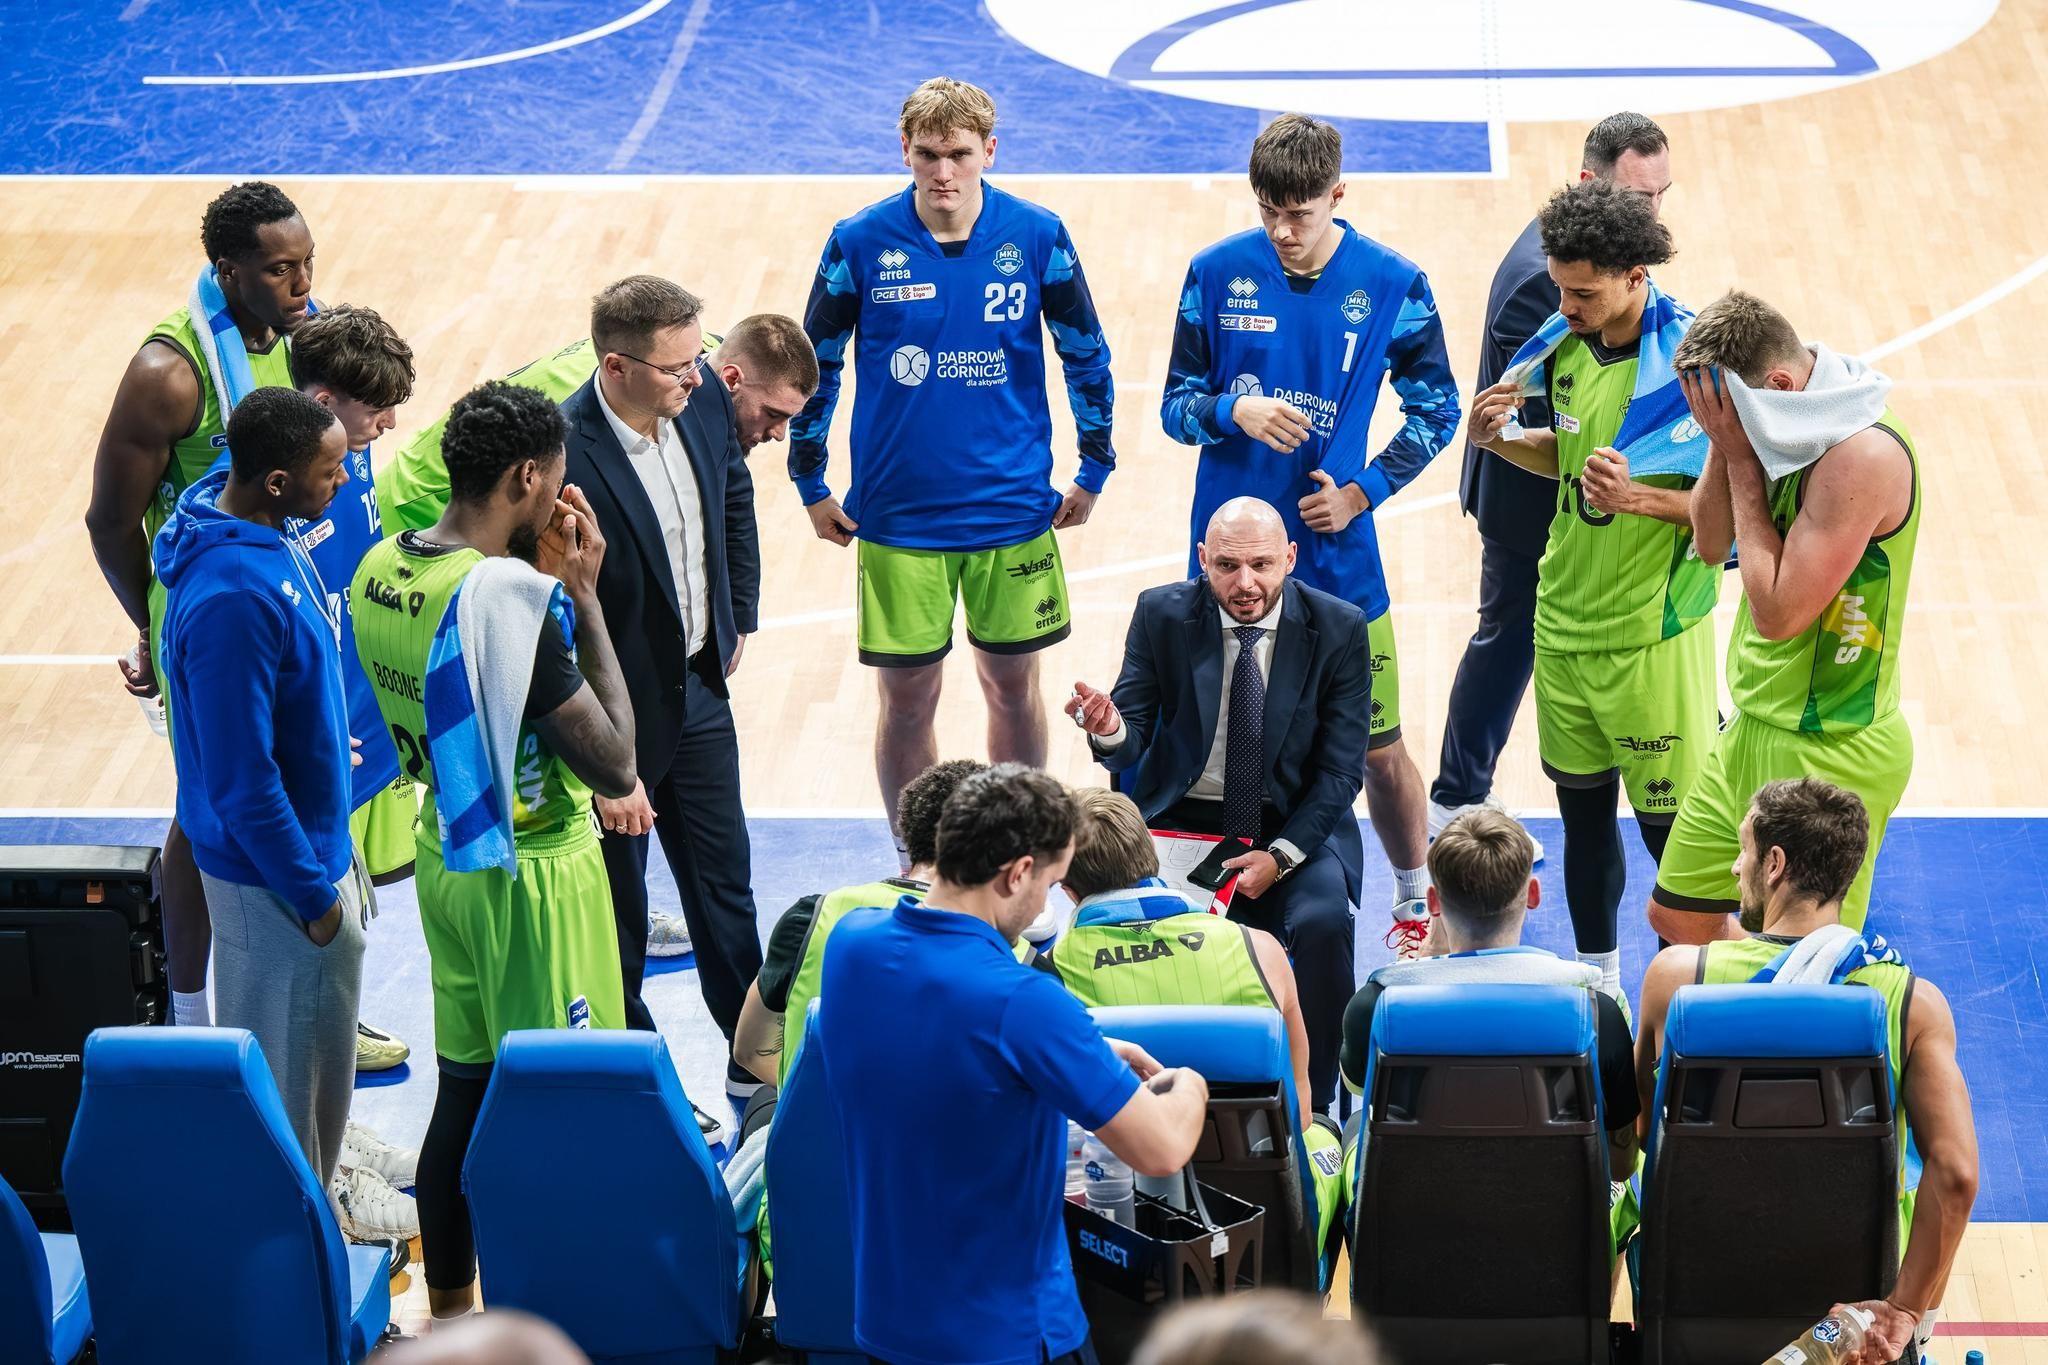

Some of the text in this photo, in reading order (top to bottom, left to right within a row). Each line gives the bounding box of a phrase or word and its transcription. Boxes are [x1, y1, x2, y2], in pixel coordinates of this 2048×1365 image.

[1000, 250, 1018, 258] MKS
[879, 269, 911, 280] errea
[876, 290, 896, 299] PGE
[984, 282, 1027, 322] 23
[1348, 296, 1367, 306] MKS
[1227, 297, 1258, 309] errea
[1341, 331, 1358, 373] 1
[966, 379, 977, 387] dla
[360, 486, 382, 535] 12
[1025, 571, 1049, 585] logistics
[364, 576, 404, 613] ALBA
[1036, 612, 1062, 629] errea
[1834, 594, 1868, 665] MKS
[373, 660, 424, 705] BOONE
[1633, 753, 1663, 761] logistics
[1646, 797, 1678, 808] errea
[1093, 938, 1175, 970] ALBA
[1079, 1229, 1128, 1268] SELECT
